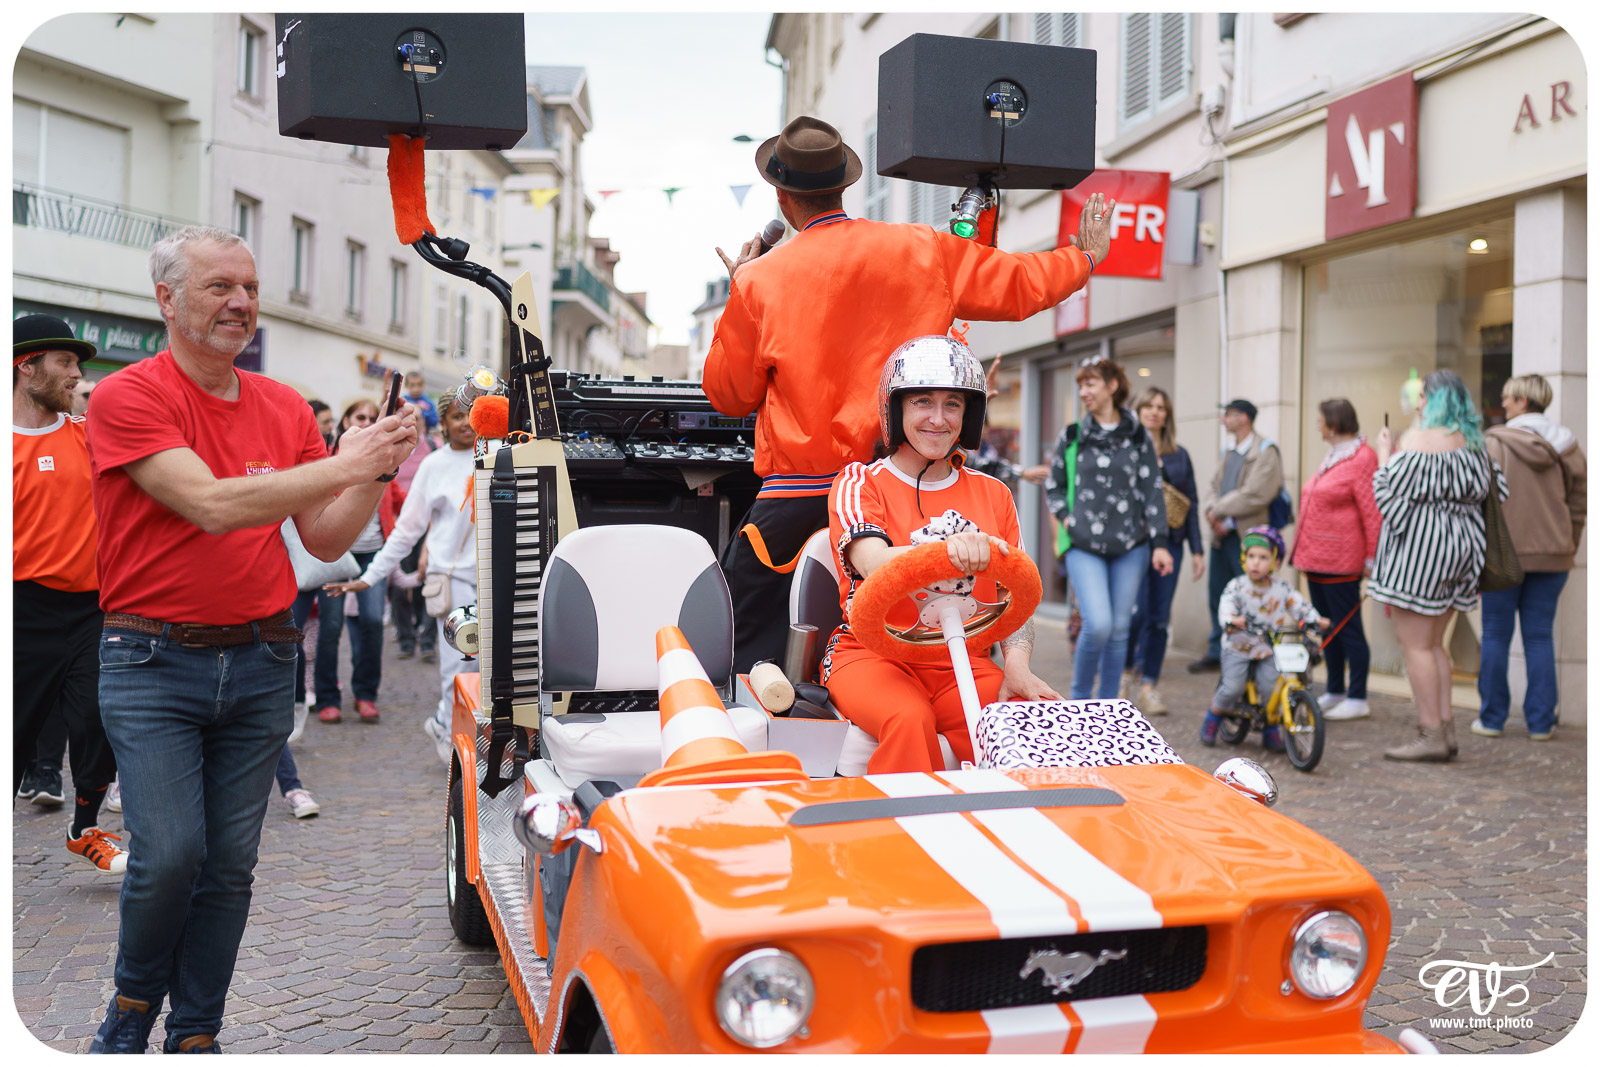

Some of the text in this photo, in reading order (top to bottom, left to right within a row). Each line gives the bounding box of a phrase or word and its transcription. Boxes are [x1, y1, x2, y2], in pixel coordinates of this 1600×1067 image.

[1513, 80, 1582, 134] AR
[1102, 202, 1165, 243] FR
[83, 320, 99, 343] la
[105, 326, 142, 350] place
[246, 467, 278, 476] L'HUMO
